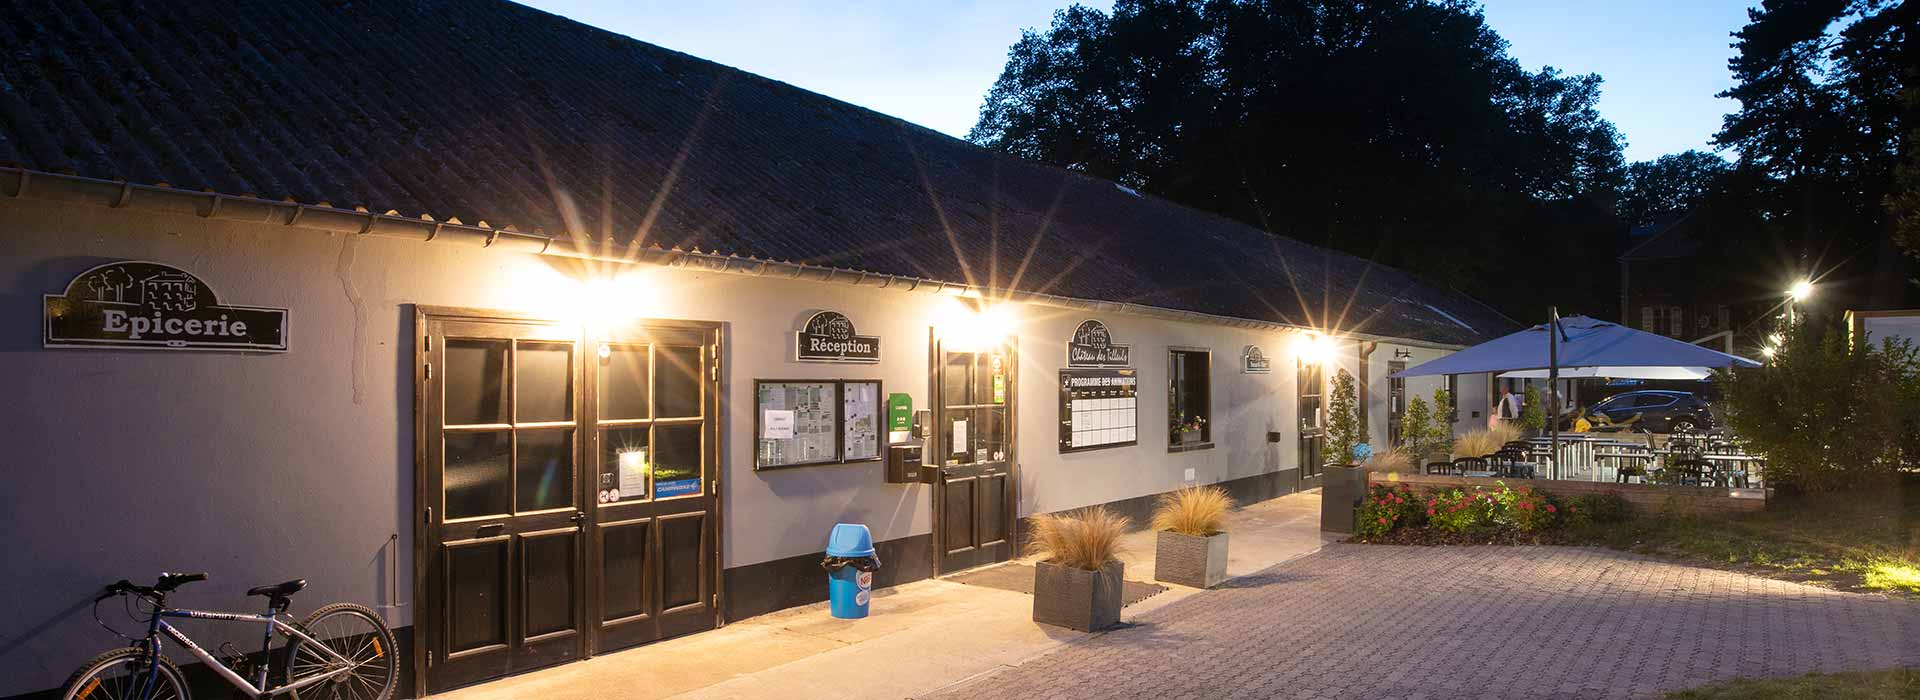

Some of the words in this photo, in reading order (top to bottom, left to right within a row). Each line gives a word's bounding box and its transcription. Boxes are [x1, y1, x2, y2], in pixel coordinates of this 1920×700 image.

[102, 309, 247, 339] Epicerie
[810, 337, 871, 356] Réception
[1071, 377, 1101, 388] PROGRAMME
[1101, 377, 1111, 386] DES
[1111, 376, 1137, 386] ANIMATIONS
